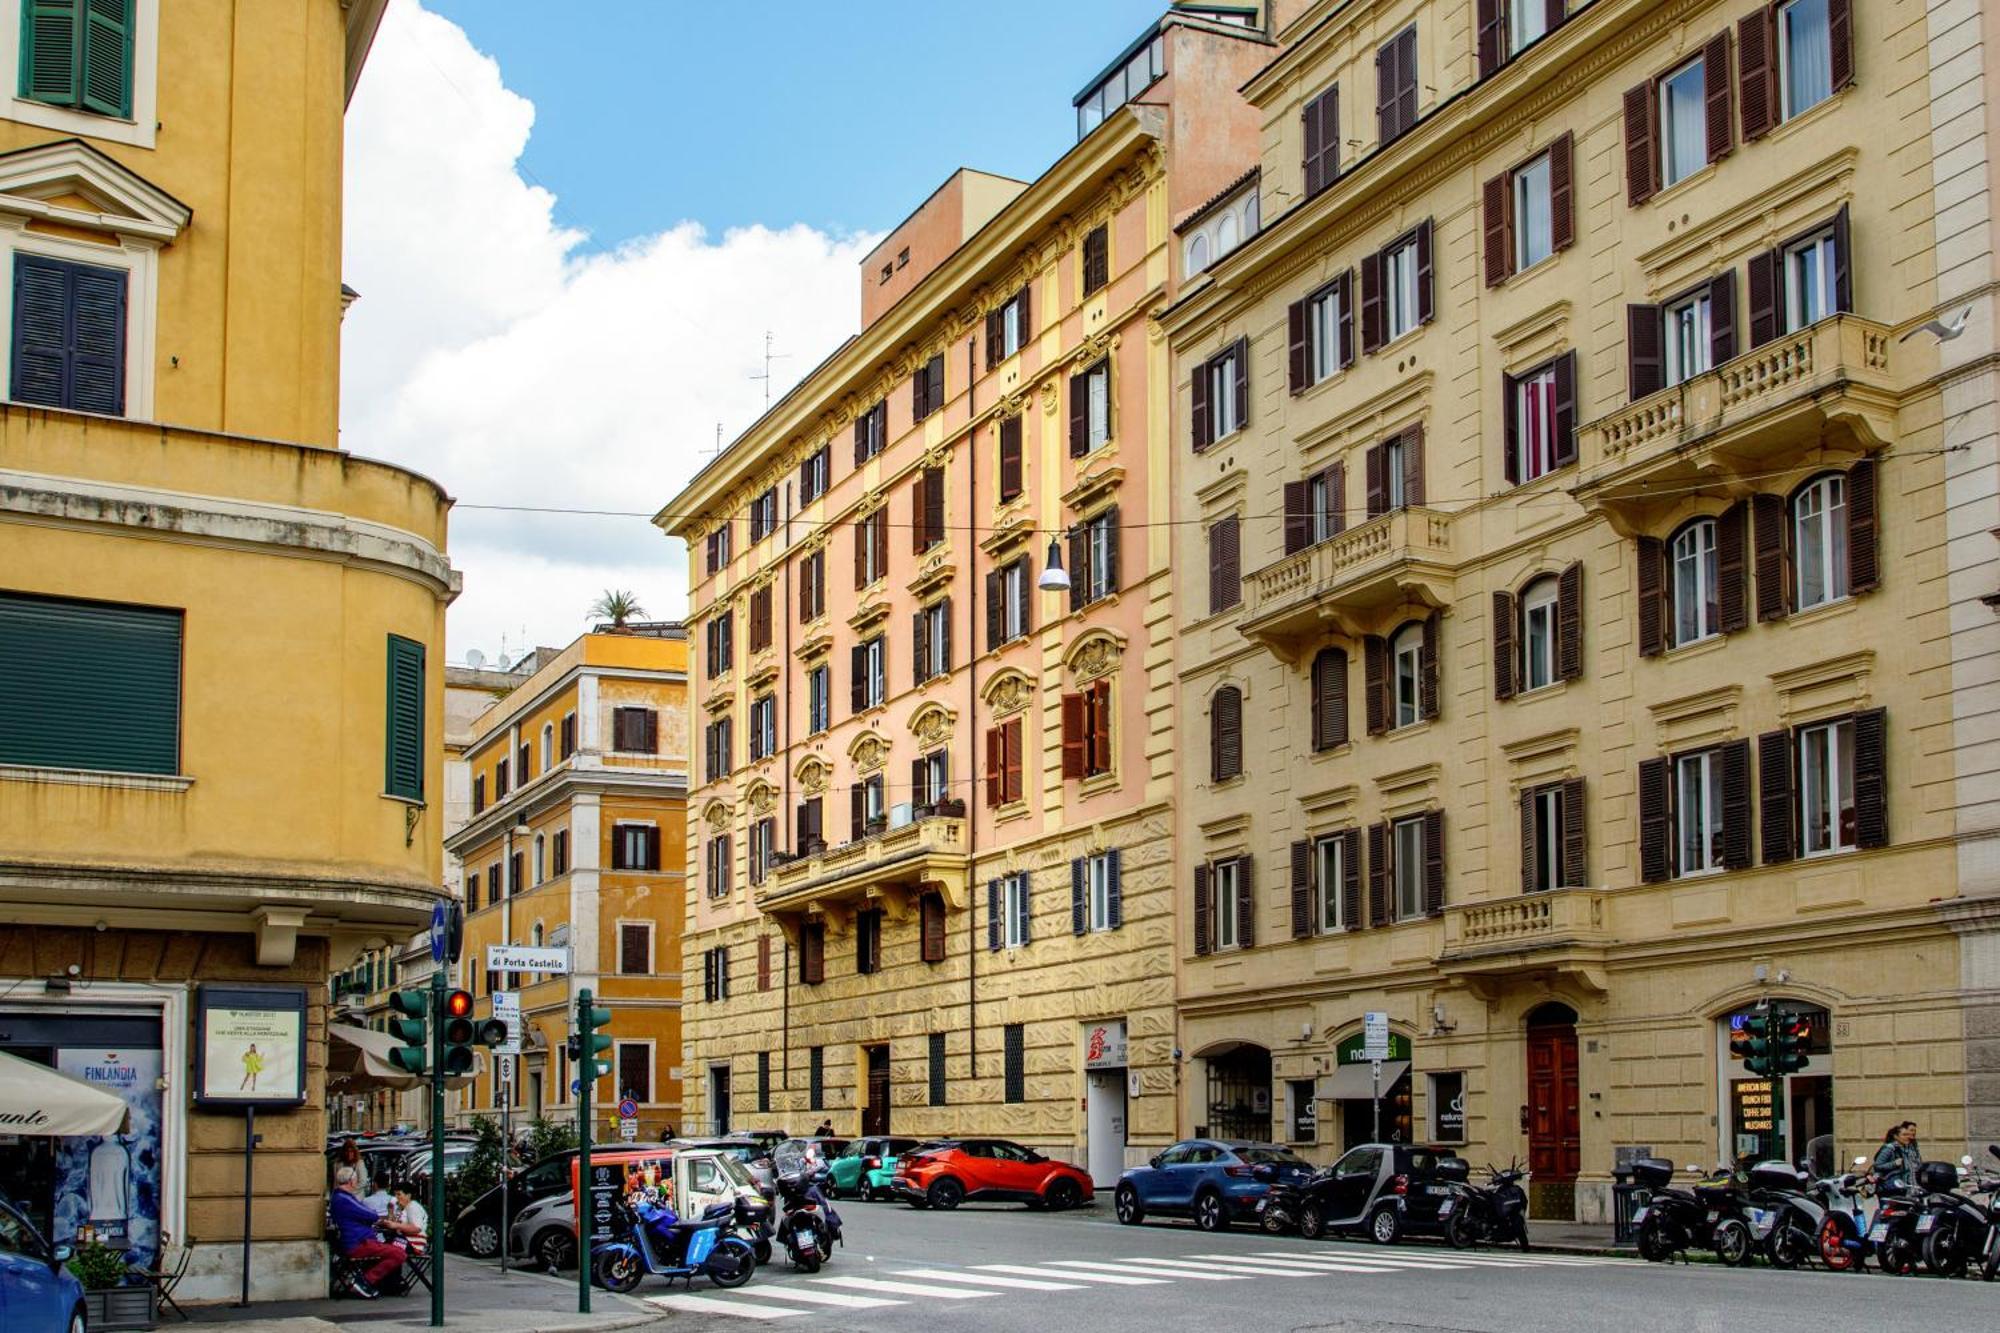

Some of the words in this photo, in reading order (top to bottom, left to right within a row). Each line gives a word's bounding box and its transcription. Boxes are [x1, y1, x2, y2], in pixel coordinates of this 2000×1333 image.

[493, 957, 500, 966] di
[503, 957, 526, 967] Porta
[529, 958, 563, 969] Castello
[85, 1067, 137, 1080] FINLANDIA
